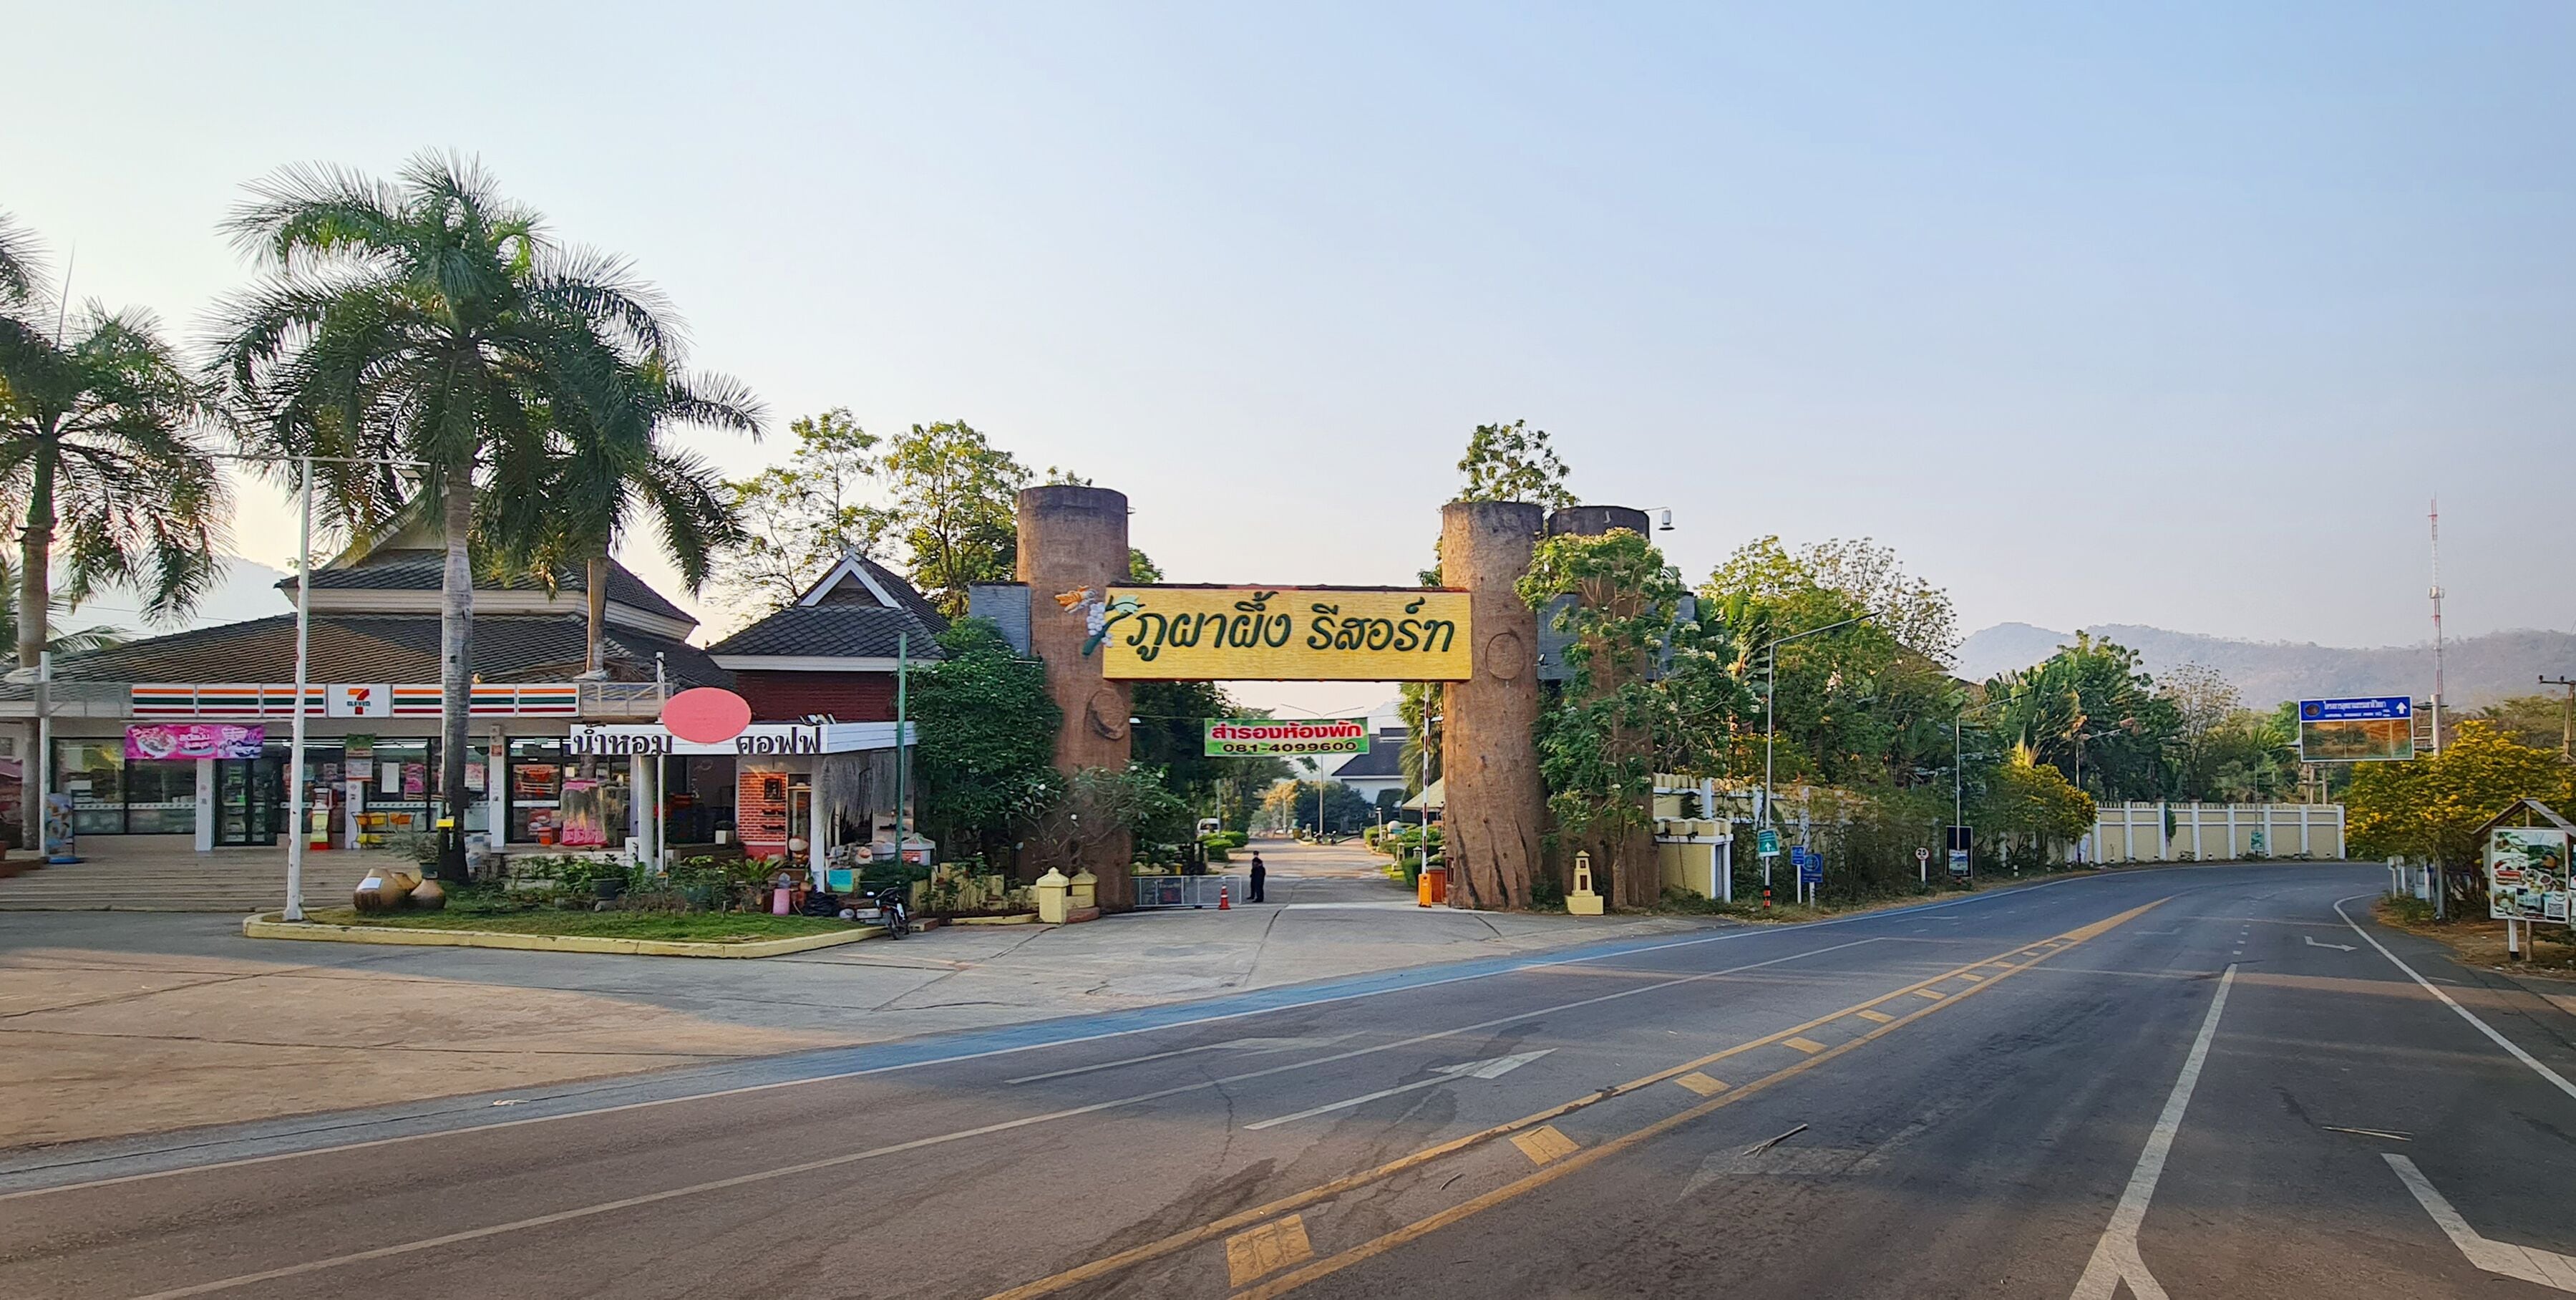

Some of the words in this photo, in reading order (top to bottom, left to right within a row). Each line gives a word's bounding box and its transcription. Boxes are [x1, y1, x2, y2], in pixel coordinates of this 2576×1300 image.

[1126, 591, 1291, 662] ภูผาผึ้ง
[1306, 596, 1455, 652] รีสอร์ท
[1212, 722, 1361, 739] สำรองห้องพัก
[1223, 742, 1356, 752] 081-4099600
